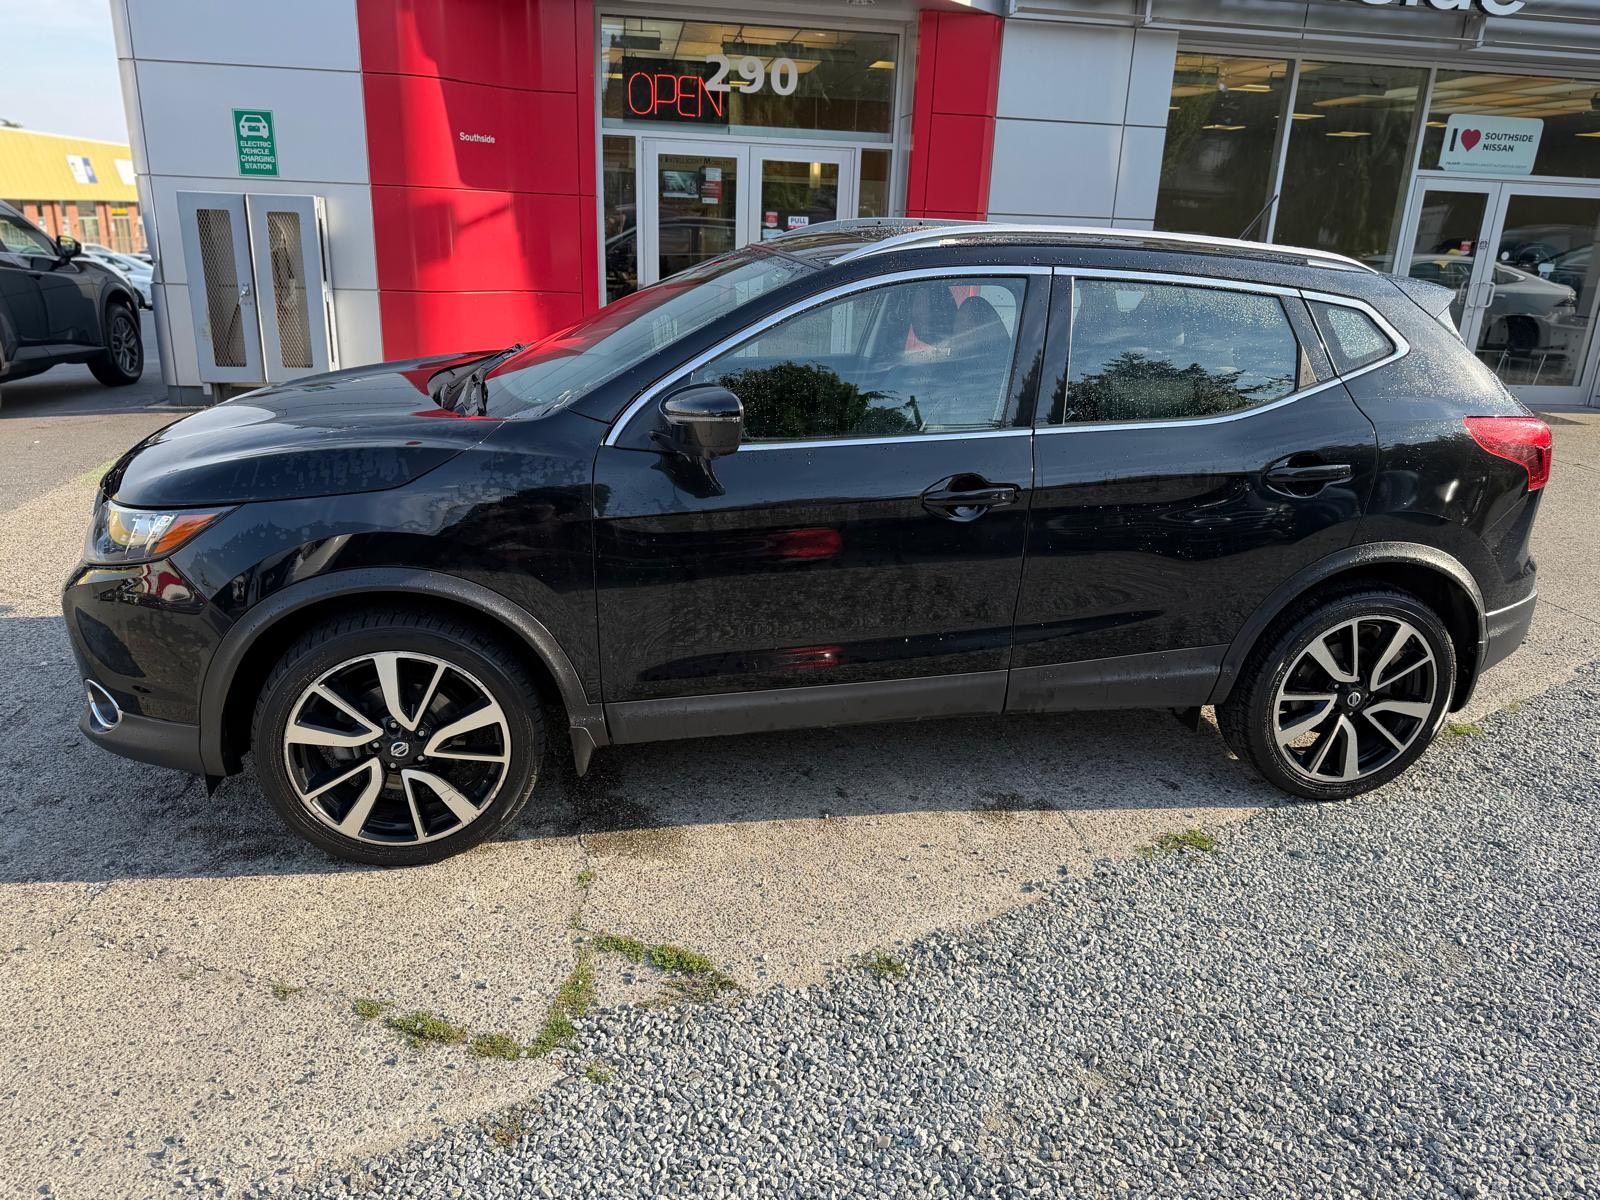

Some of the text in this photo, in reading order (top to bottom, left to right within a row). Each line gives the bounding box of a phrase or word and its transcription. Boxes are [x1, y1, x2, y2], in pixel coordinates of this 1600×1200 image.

[704, 54, 798, 96] 290
[628, 72, 722, 117] OPEN
[459, 131, 496, 144] Southside
[1484, 132, 1534, 142] SOUTHSIDE
[1482, 144, 1514, 152] NISSAN
[240, 155, 275, 163] CHARGING
